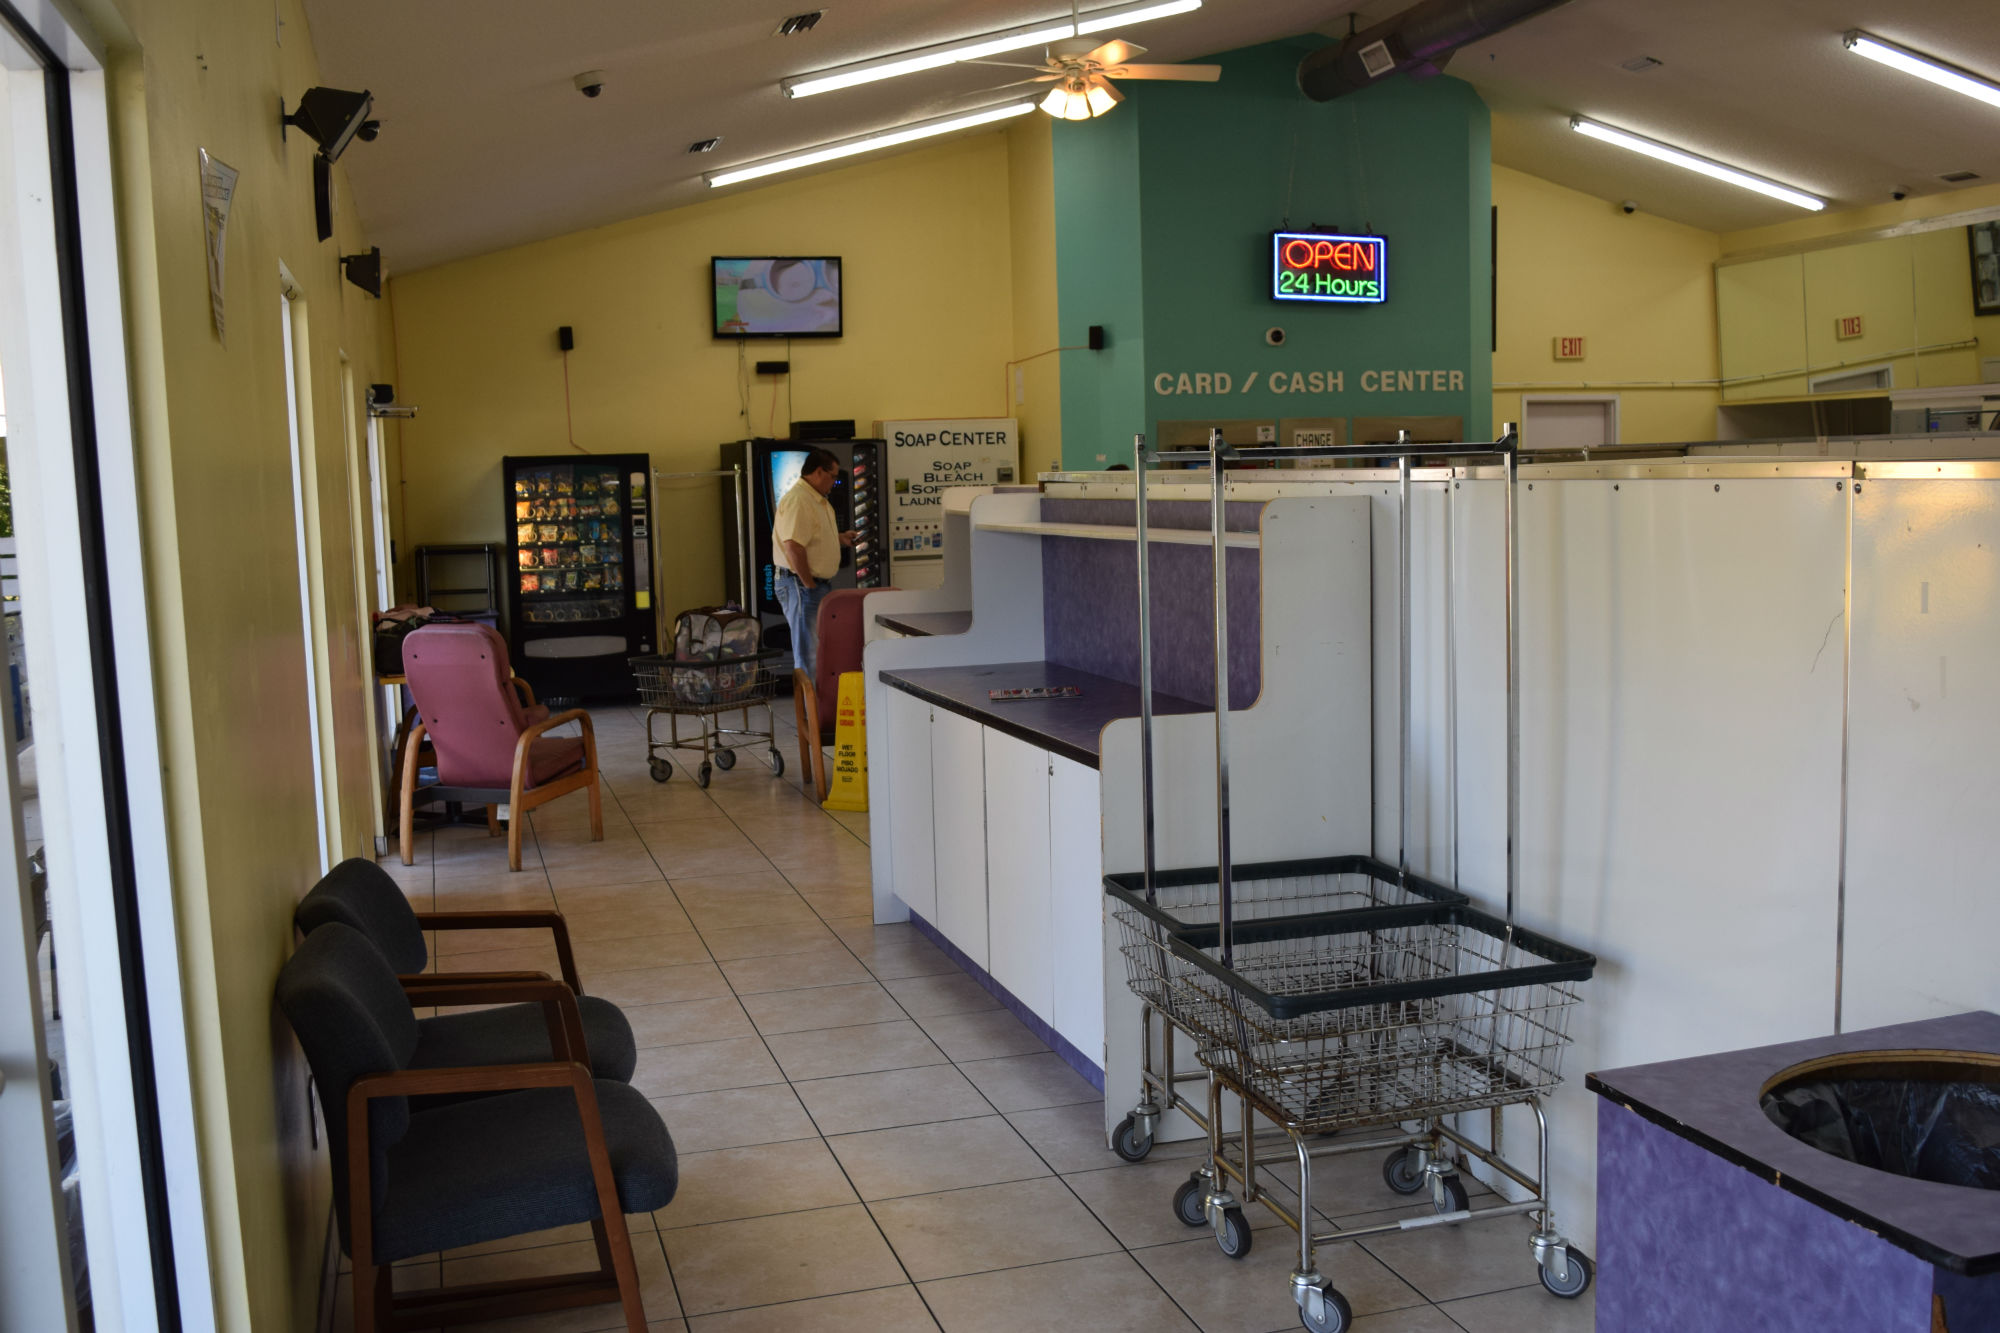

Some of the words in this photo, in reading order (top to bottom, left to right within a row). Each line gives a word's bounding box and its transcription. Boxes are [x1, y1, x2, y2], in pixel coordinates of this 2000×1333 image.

[1285, 240, 1375, 271] OPEN
[1280, 271, 1310, 294] 24
[1316, 273, 1379, 297] Hours
[1561, 337, 1583, 357] EXIT
[1154, 372, 1232, 396] CARD
[1268, 371, 1344, 394] CASH
[1360, 370, 1465, 393] CENTER
[1296, 433, 1332, 447] CHANGE
[763, 564, 773, 601] refresh
